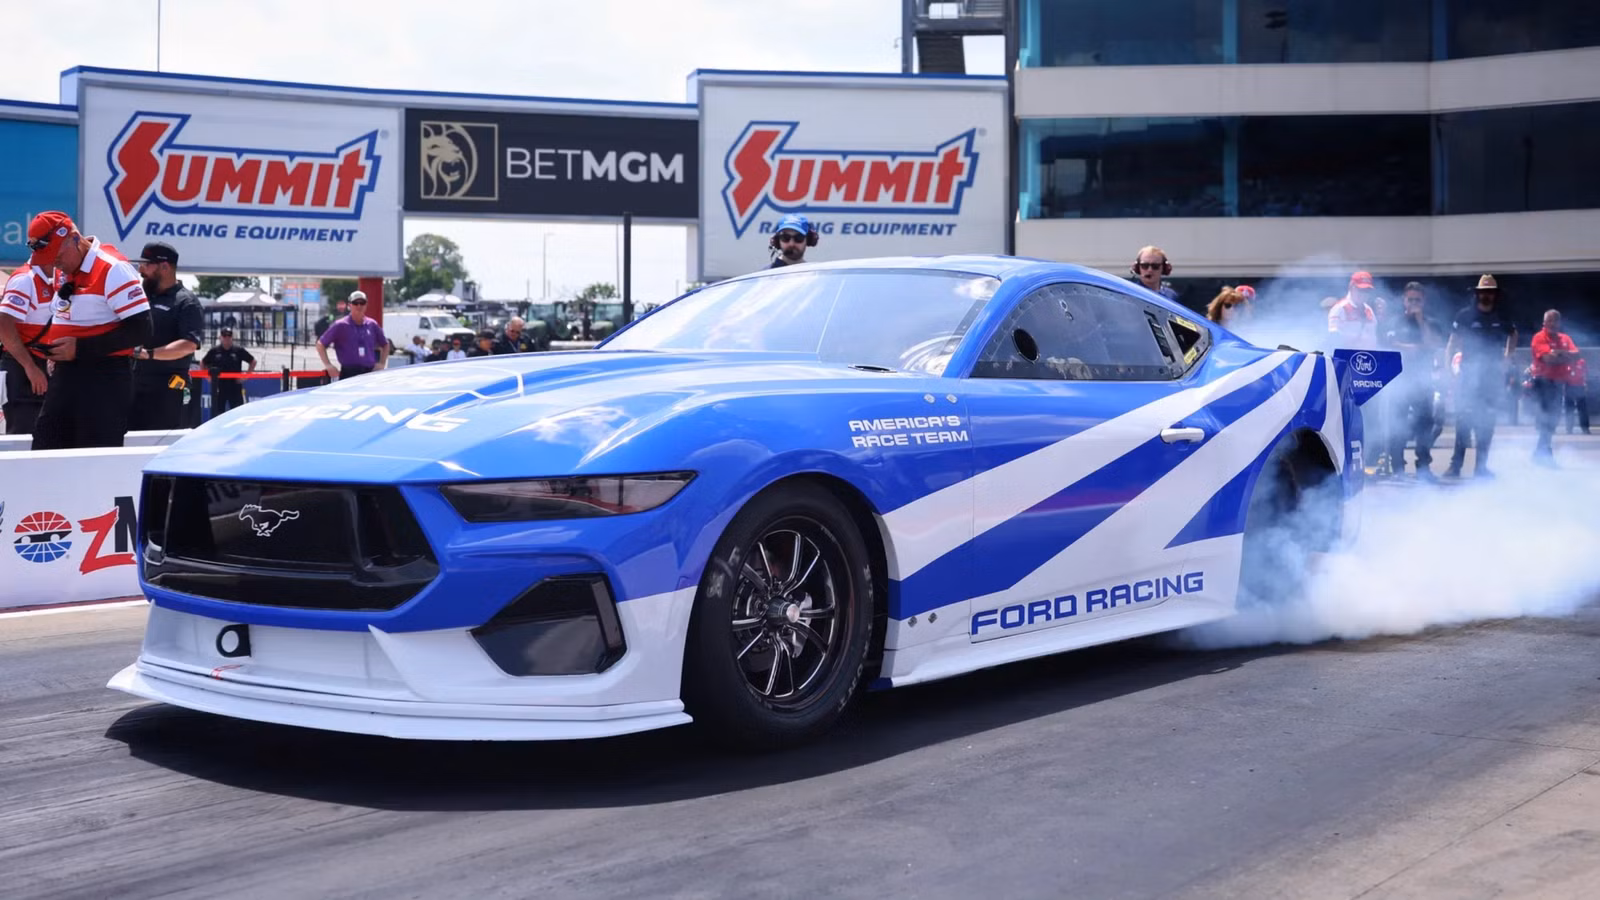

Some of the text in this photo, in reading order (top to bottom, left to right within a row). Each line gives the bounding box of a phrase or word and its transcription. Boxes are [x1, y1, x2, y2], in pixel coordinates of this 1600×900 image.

[506, 147, 684, 183] BETMGM
[145, 222, 358, 242] RACING EQUIPMENT
[759, 221, 957, 236] RNG EQUIPMENT
[1353, 380, 1383, 388] RACING
[223, 404, 470, 433] RACING
[848, 415, 961, 432] AMERICA'S
[851, 430, 969, 448] RACE TEAM
[971, 571, 1204, 635] FORD RACING
